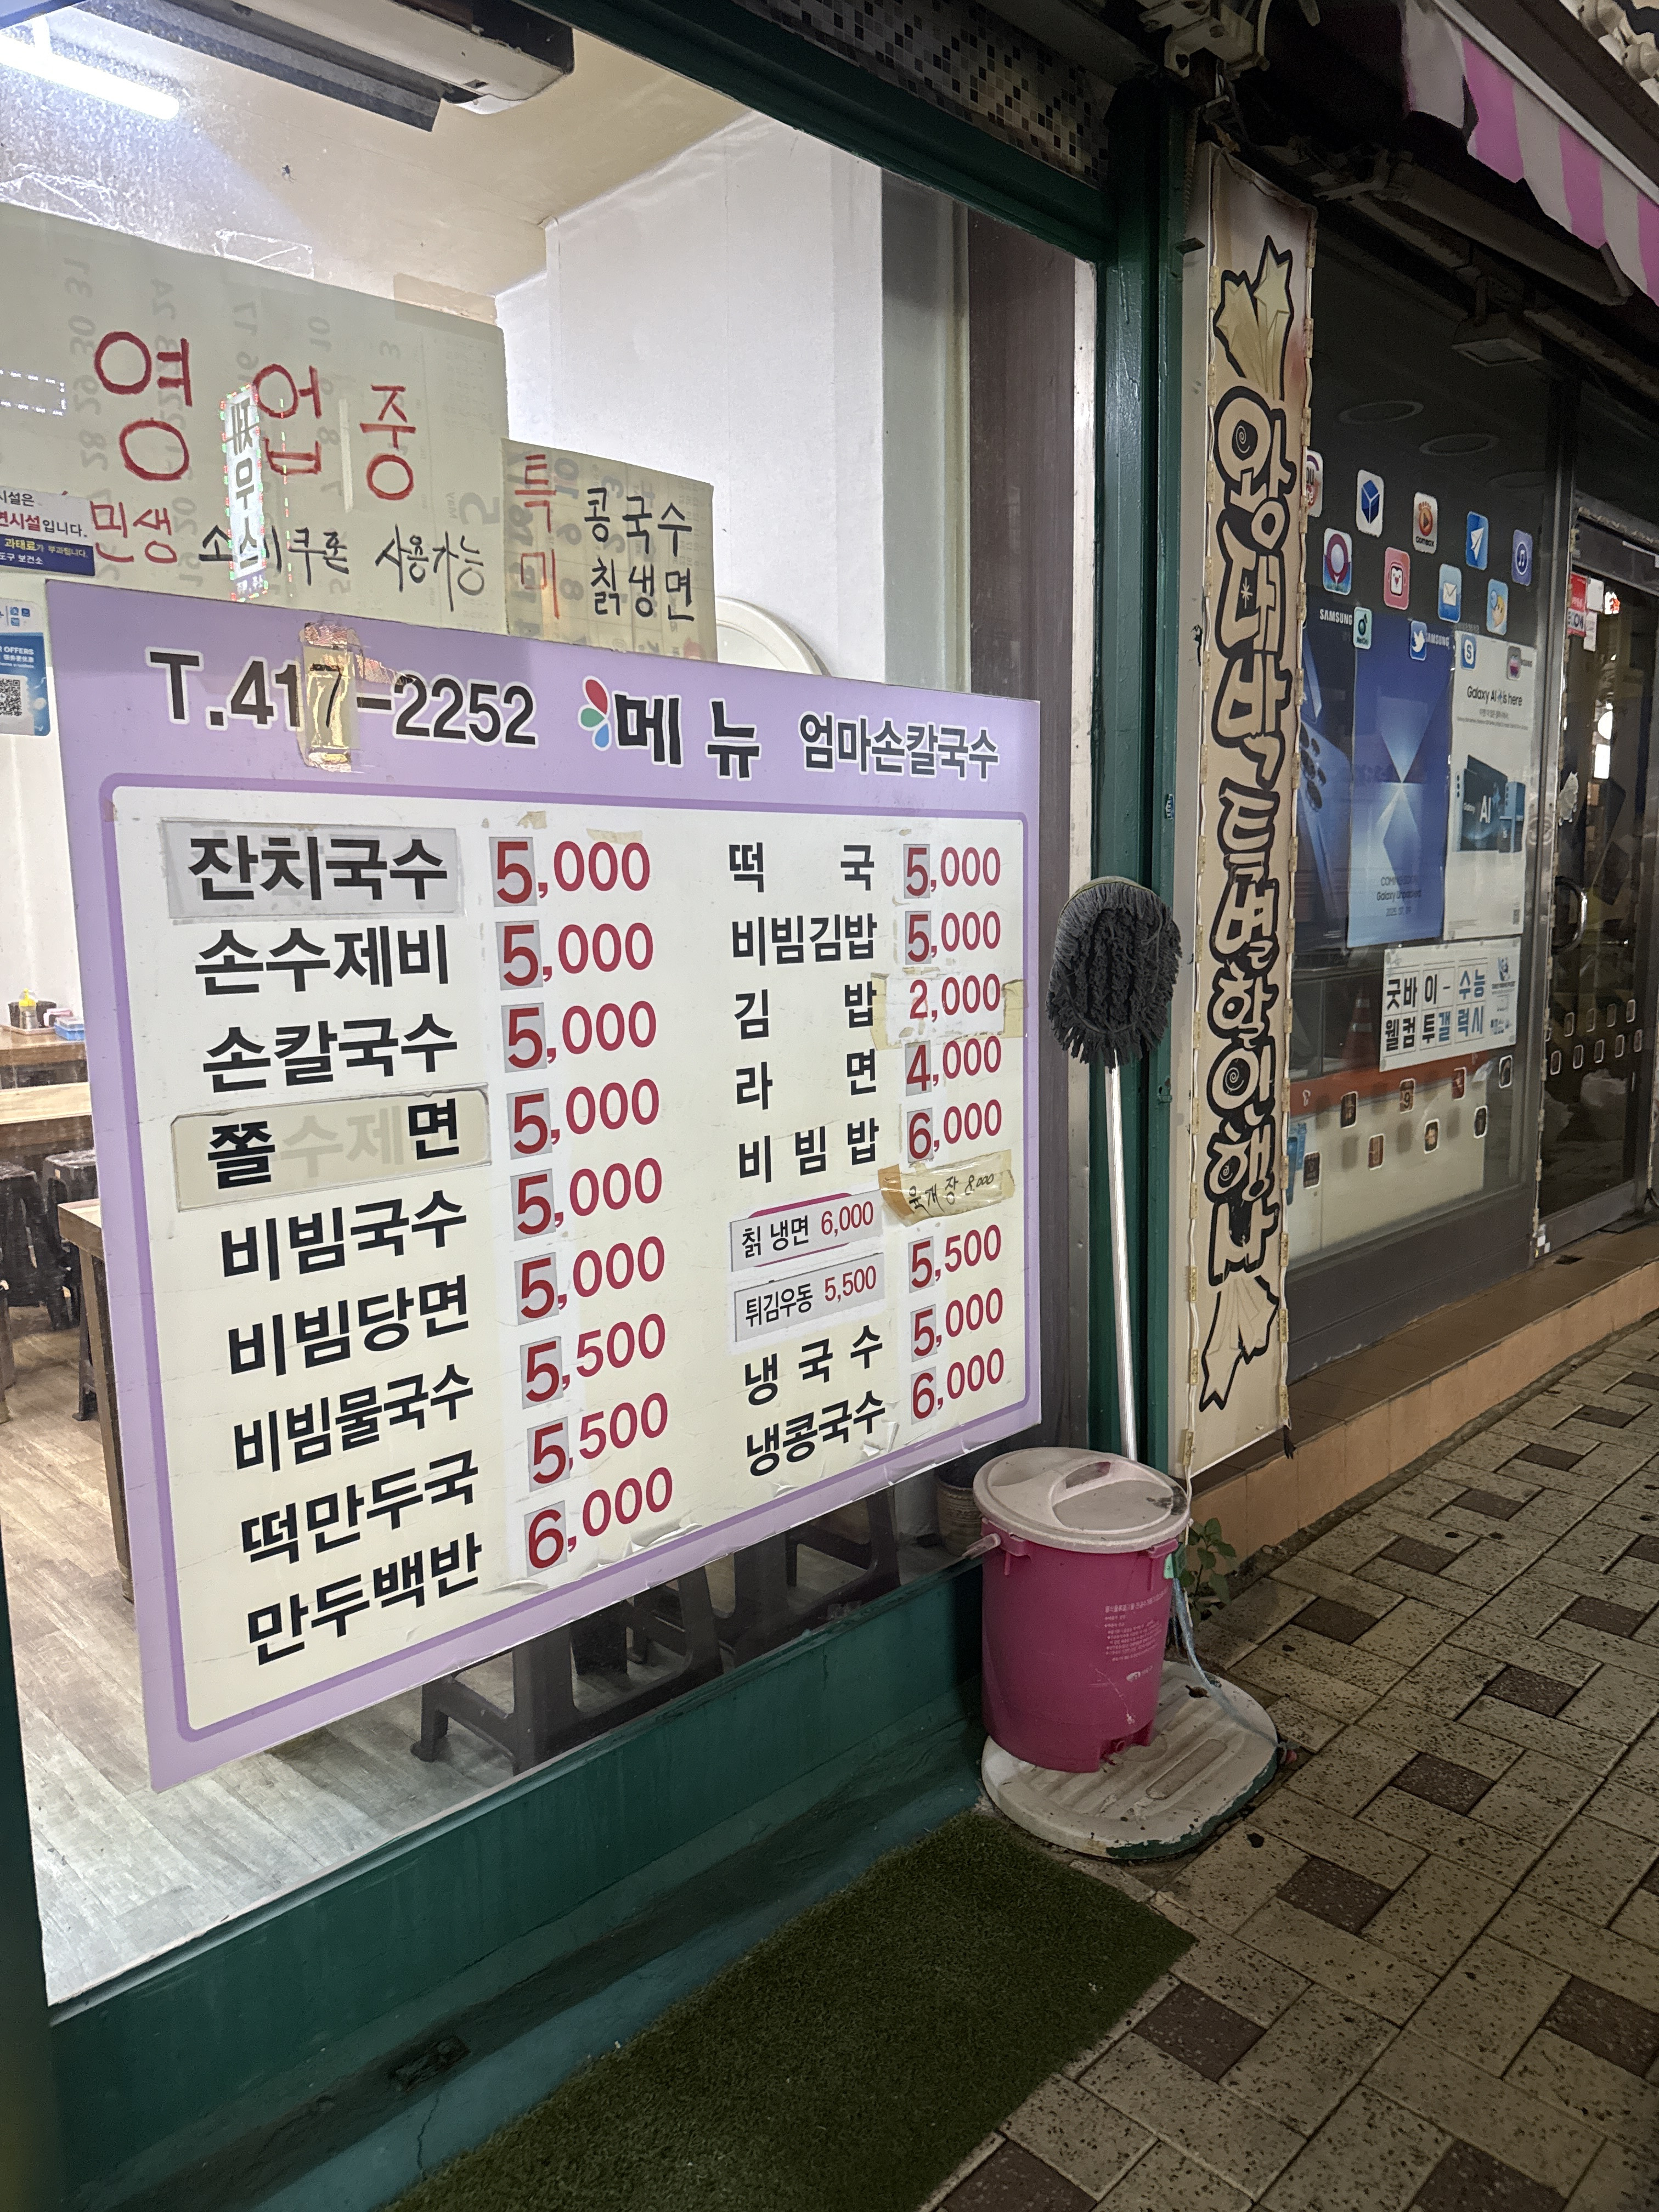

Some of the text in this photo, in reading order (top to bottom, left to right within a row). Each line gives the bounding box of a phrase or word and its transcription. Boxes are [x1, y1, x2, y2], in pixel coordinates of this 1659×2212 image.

[5, 538, 43, 552] 과태료가
[91, 500, 484, 611] 민생 소쿠폰 사용가능
[585, 488, 692, 557] 콩국수
[18, 554, 43, 565] 보건소
[591, 557, 694, 621] 칡냉면
[4, 646, 35, 655] OFFERS
[1319, 609, 1352, 625] SAMSUNG
[1467, 686, 1490, 704] Galaxy
[1490, 690, 1497, 702] AI
[1508, 693, 1523, 707] here
[799, 713, 998, 781] 엄마손칼국수
[1480, 795, 1491, 823] AI
[188, 835, 650, 905] 잔치국수 5,000
[906, 847, 1001, 896] 5,000
[195, 922, 653, 996] 손수제비 5,000
[732, 911, 1001, 966] 비빔김밥 5,000
[909, 973, 1001, 1023] 2,000
[1459, 969, 1485, 1000] 수능
[203, 1001, 657, 1093] 손칼국수 5,000
[906, 1035, 1001, 1092] 4,000
[514, 1078, 659, 1154] 5,000
[909, 1099, 1002, 1159] 6,000
[221, 1158, 663, 1281] 비빔국수 5,000
[742, 1201, 874, 1259] 칡 냉면 6,000
[228, 1235, 665, 1376] 비빔당면 5,000
[746, 1224, 1001, 1328] 튀김우동 5,500 5,500
[913, 1288, 1003, 1357] 5,000
[234, 1313, 666, 1472] 비빔물국수 5,500
[747, 1348, 1004, 1477] 냉콩국수 6,000
[241, 1392, 668, 1564] 떡만두국 5,500
[247, 1467, 673, 1666] 만두백반 6,000
